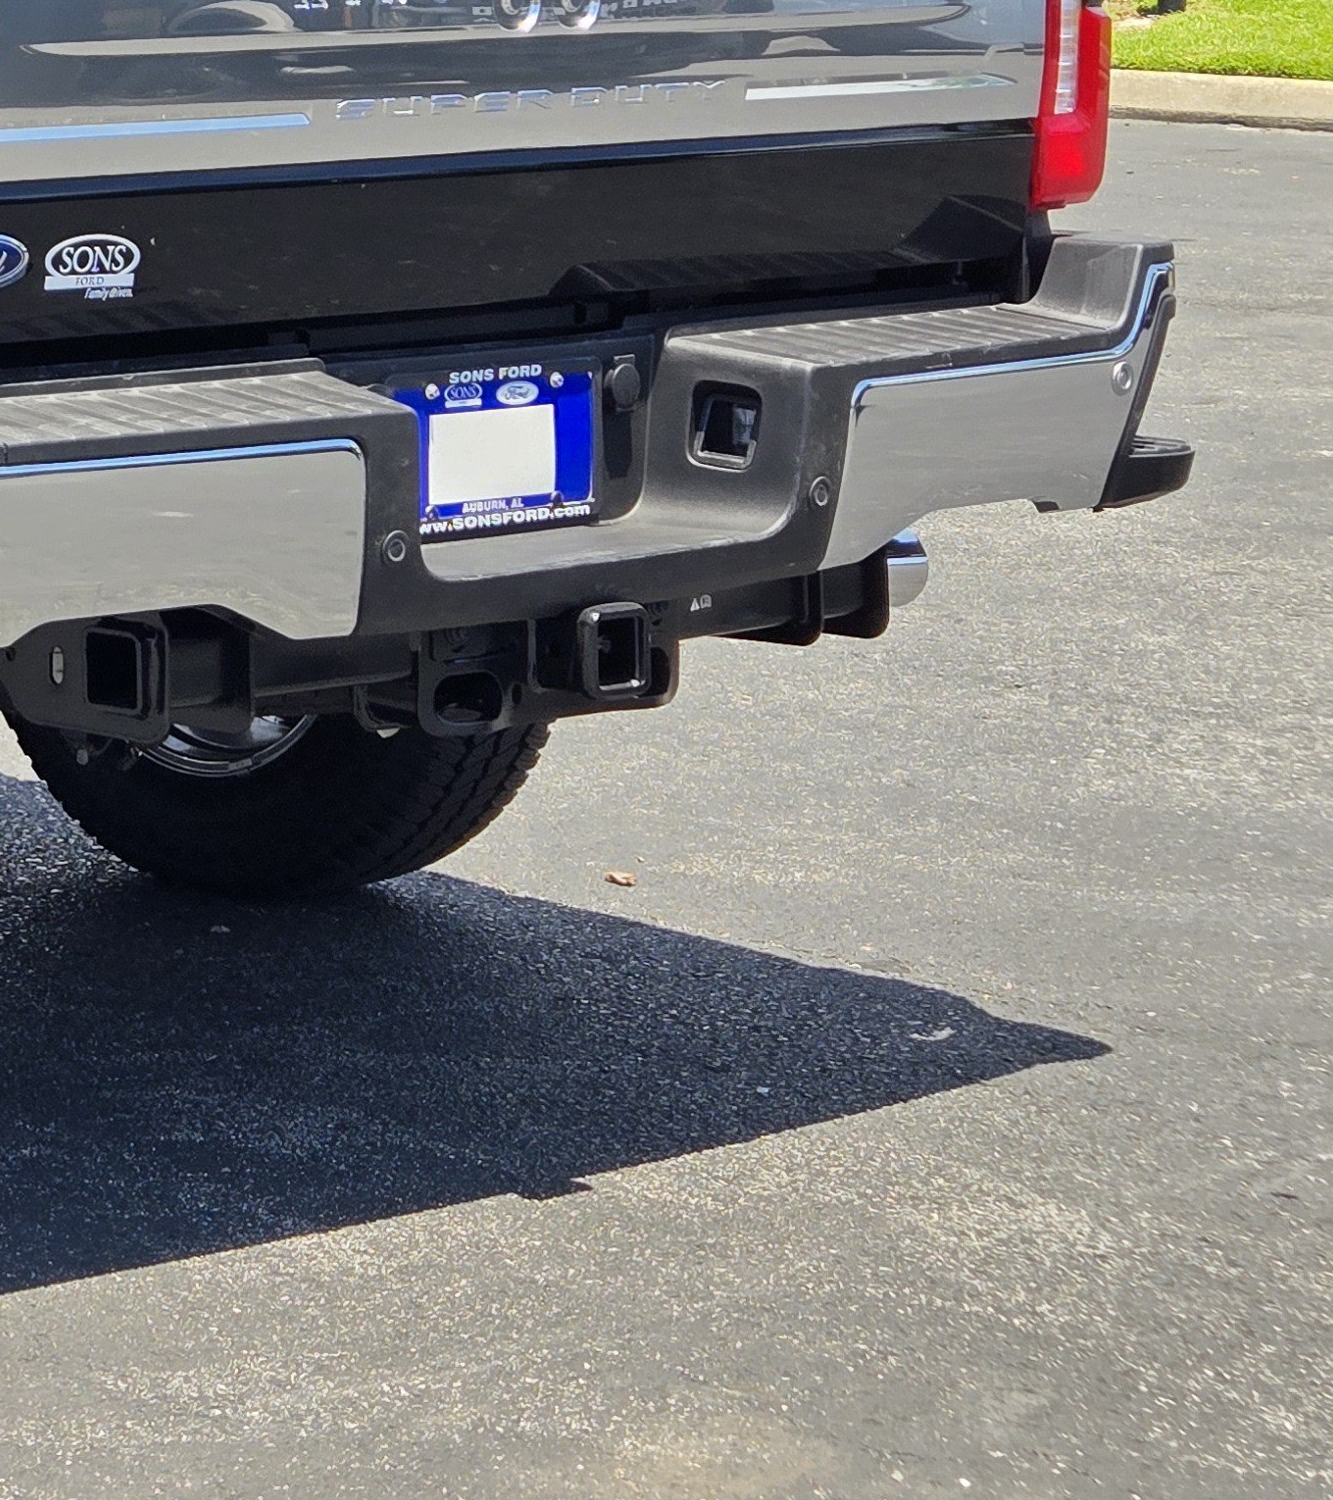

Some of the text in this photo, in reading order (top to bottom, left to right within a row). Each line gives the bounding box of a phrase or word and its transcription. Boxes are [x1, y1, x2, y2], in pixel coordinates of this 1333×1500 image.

[335, 79, 729, 122] SUPER DUTY
[58, 245, 128, 274] SONS
[74, 276, 106, 287] FORD
[448, 363, 543, 385] SONS FORD
[461, 497, 525, 514] AUBURN, AL
